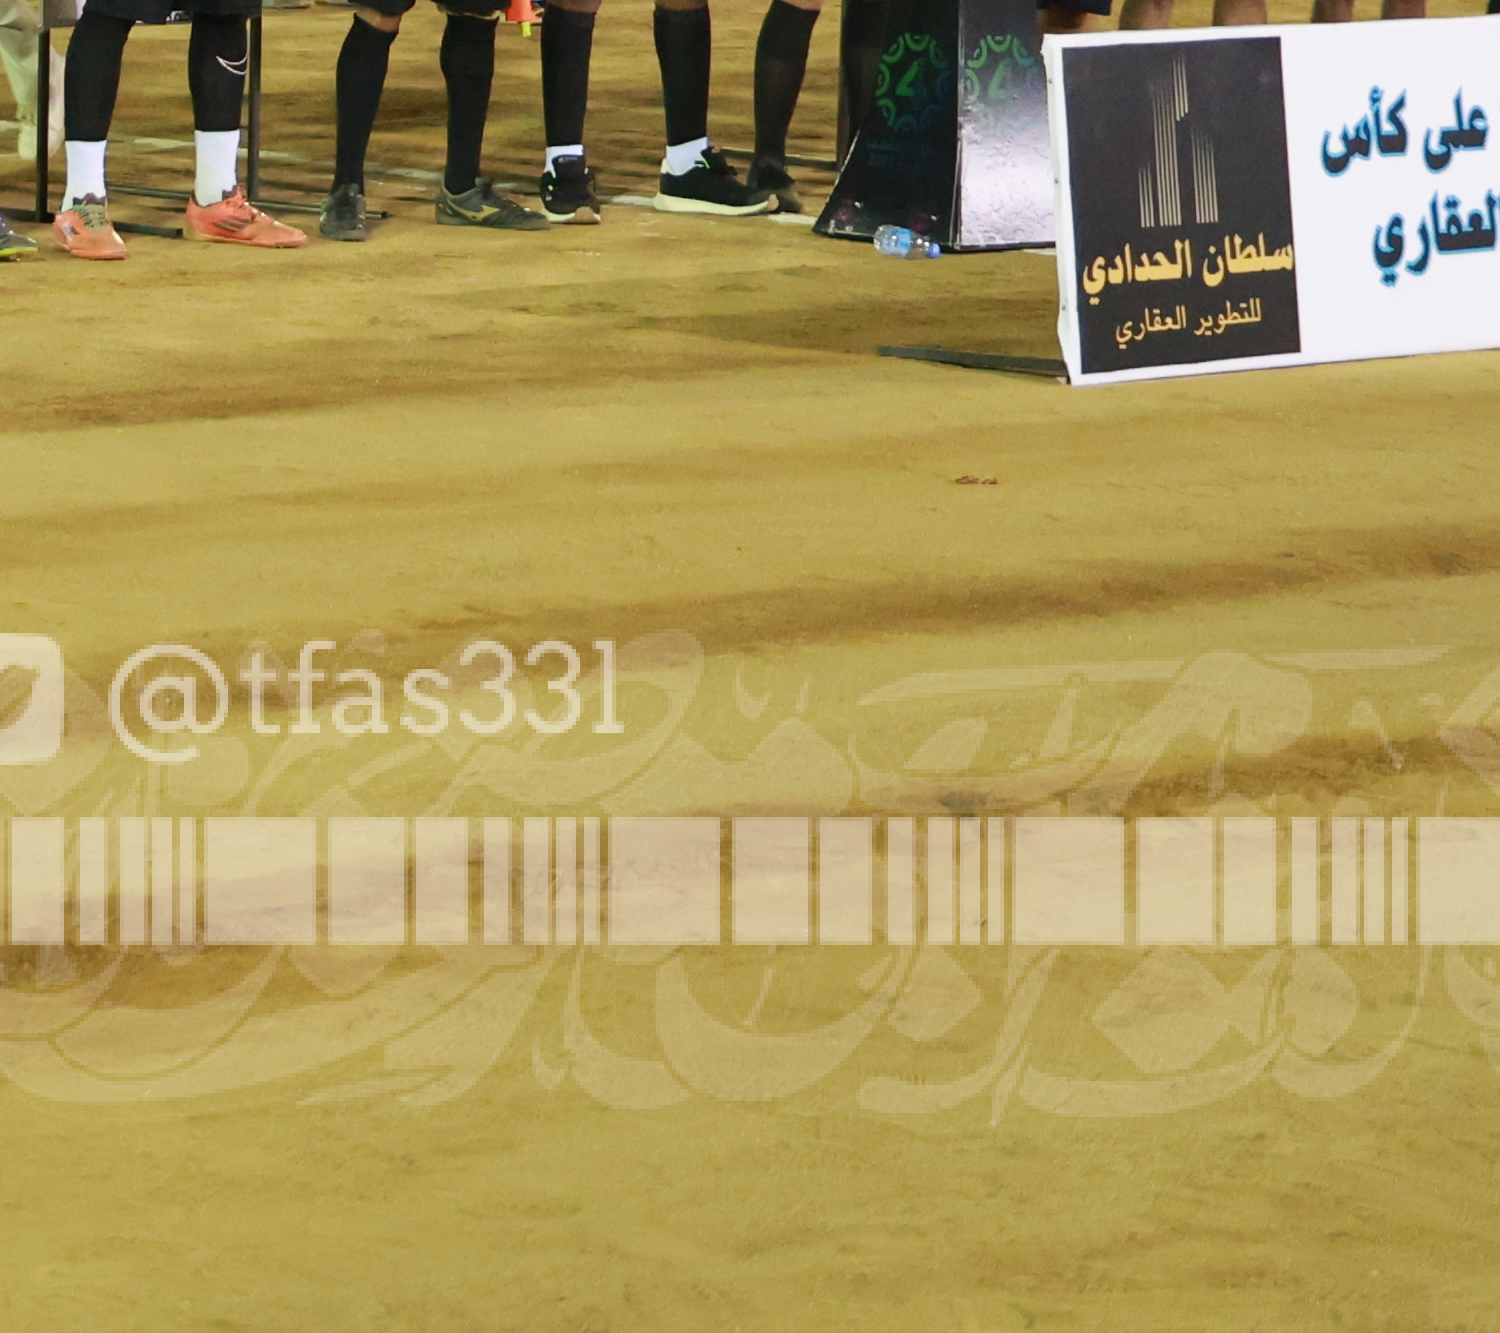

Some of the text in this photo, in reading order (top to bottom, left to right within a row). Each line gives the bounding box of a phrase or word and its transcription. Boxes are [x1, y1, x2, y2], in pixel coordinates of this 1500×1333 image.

[1321, 84, 1408, 178] كأس
[1423, 84, 1489, 174] على
[1082, 233, 1293, 305] سلطان الحدادي
[1116, 298, 1262, 349] للتطوير العقاري
